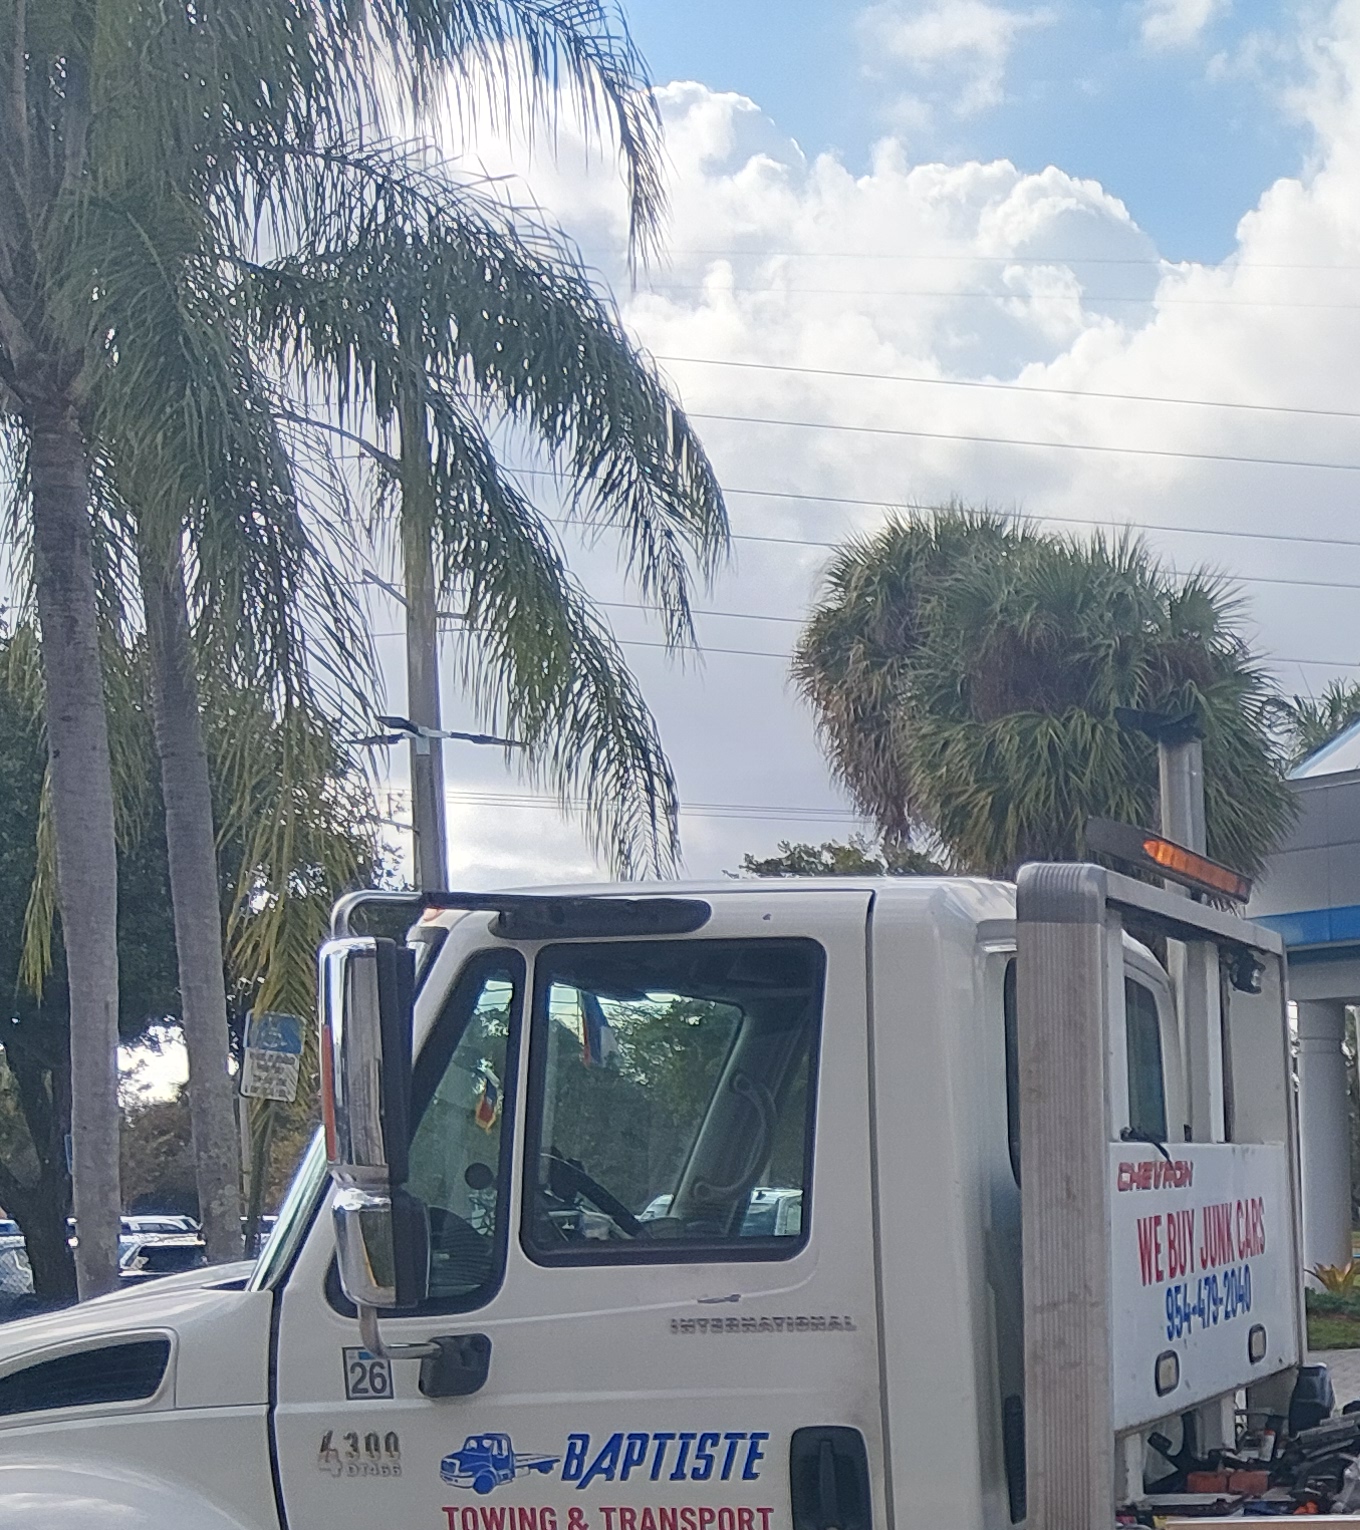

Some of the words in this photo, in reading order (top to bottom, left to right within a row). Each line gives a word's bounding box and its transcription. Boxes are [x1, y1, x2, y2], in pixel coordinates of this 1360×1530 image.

[1118, 1161, 1194, 1192] CHEVRON
[1137, 1215, 1164, 1287] WE
[1167, 1208, 1195, 1280] BUY
[1200, 1202, 1235, 1271] JUNK
[1236, 1196, 1266, 1261] CARS
[671, 1316, 857, 1334] INTERNATIONAL
[1166, 1263, 1251, 1342] 954-479-2040
[350, 1361, 388, 1394] 26
[560, 1431, 770, 1490] BAPTISTE
